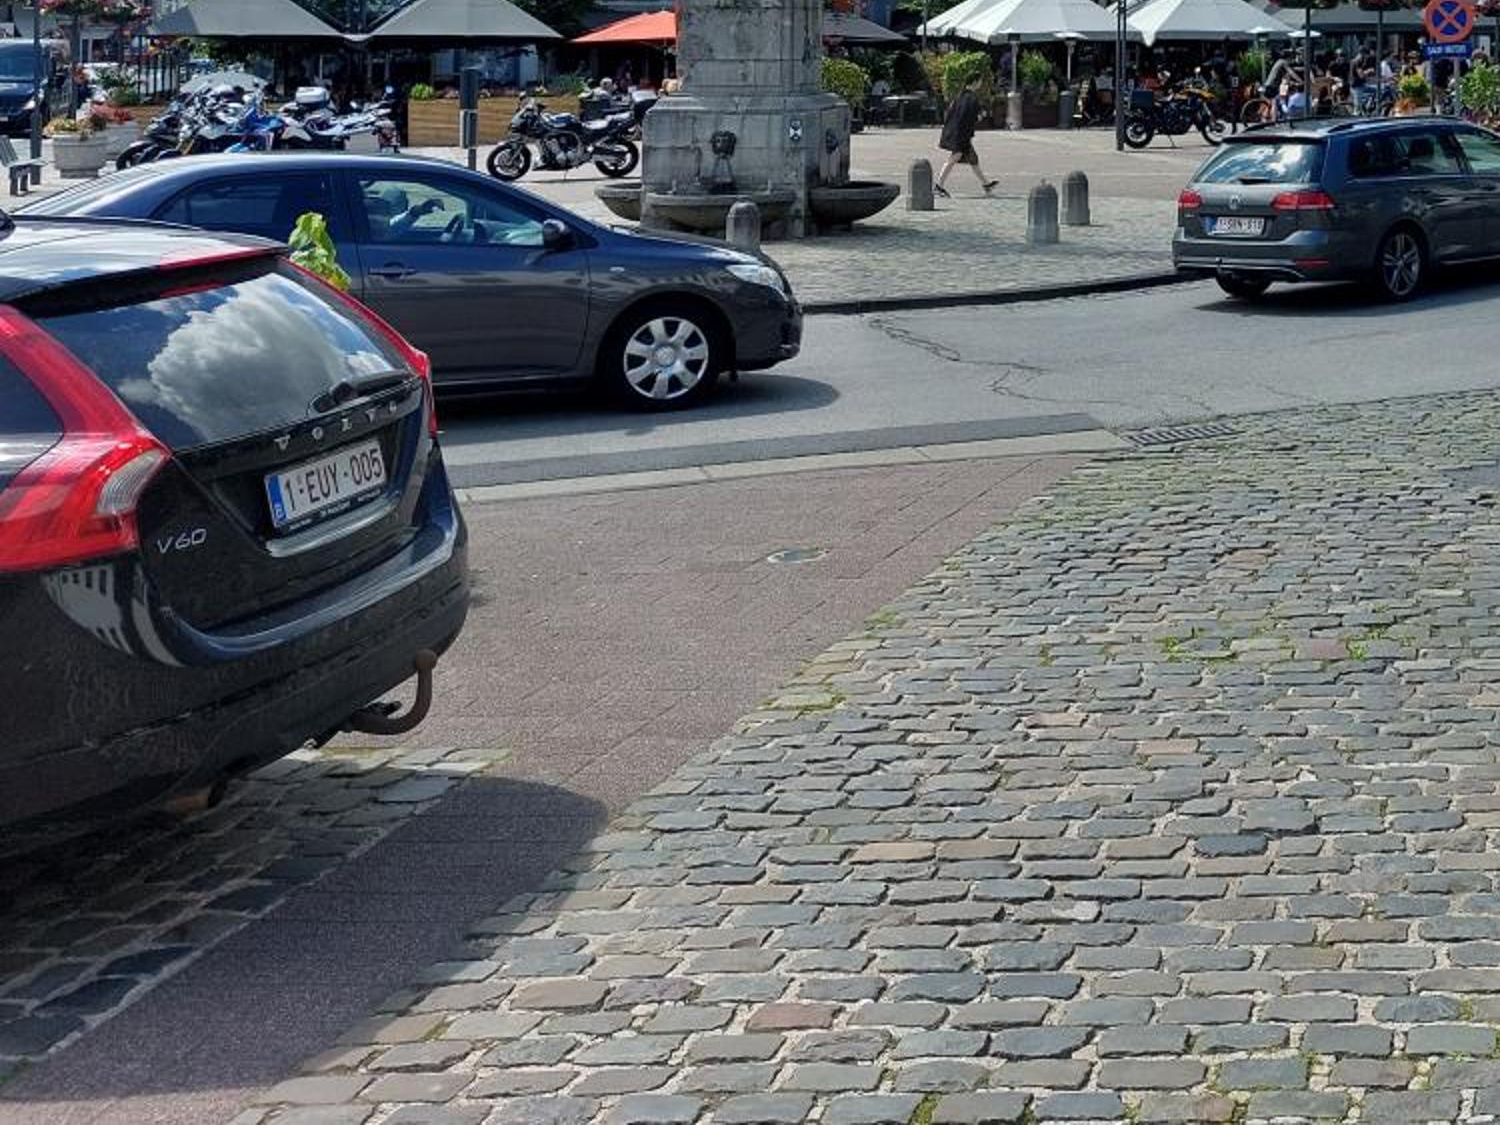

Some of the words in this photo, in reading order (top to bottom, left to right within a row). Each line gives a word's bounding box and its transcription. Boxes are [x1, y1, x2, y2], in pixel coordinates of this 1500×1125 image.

[274, 401, 397, 451] VOLVO
[285, 448, 383, 512] 1-EUY-005
[157, 528, 207, 554] V60
